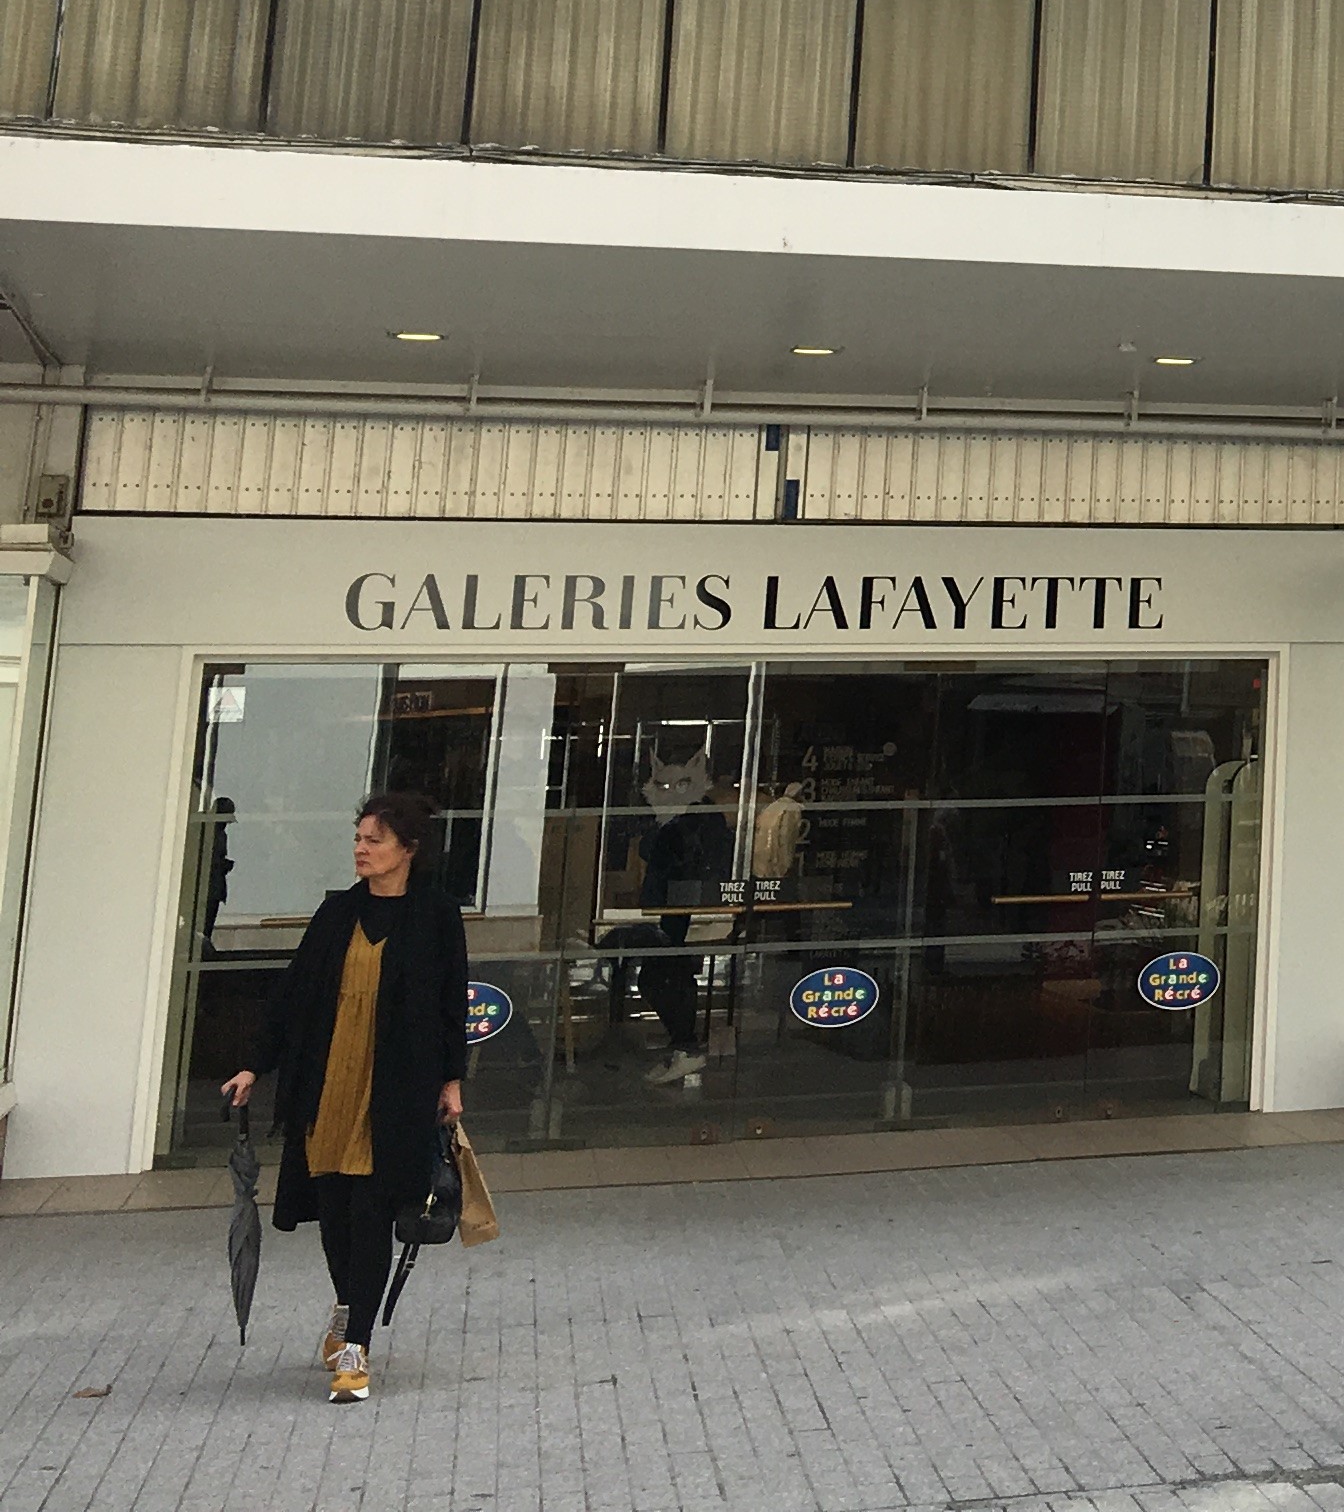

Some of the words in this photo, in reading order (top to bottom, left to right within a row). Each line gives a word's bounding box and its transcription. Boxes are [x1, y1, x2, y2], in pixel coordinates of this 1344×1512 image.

[345, 572, 731, 632] GALERIES
[763, 574, 1164, 631] LAFAYETTE
[802, 745, 818, 771] 4
[1069, 872, 1093, 882] TIREZ
[1102, 870, 1125, 880] TIREZ
[720, 882, 745, 892] TIREZ
[756, 880, 781, 890] TIREZ
[1101, 880, 1121, 890] PULL
[722, 893, 743, 903] PULL
[754, 891, 776, 900] PULL
[1168, 958, 1188, 970] La
[823, 973, 844, 986] La
[1149, 972, 1207, 986] Grande
[802, 987, 866, 1003] Grande
[1154, 985, 1201, 1001] Récré
[467, 1002, 497, 1016] nde
[807, 1002, 858, 1019] Récré
[465, 1017, 489, 1033] cré
